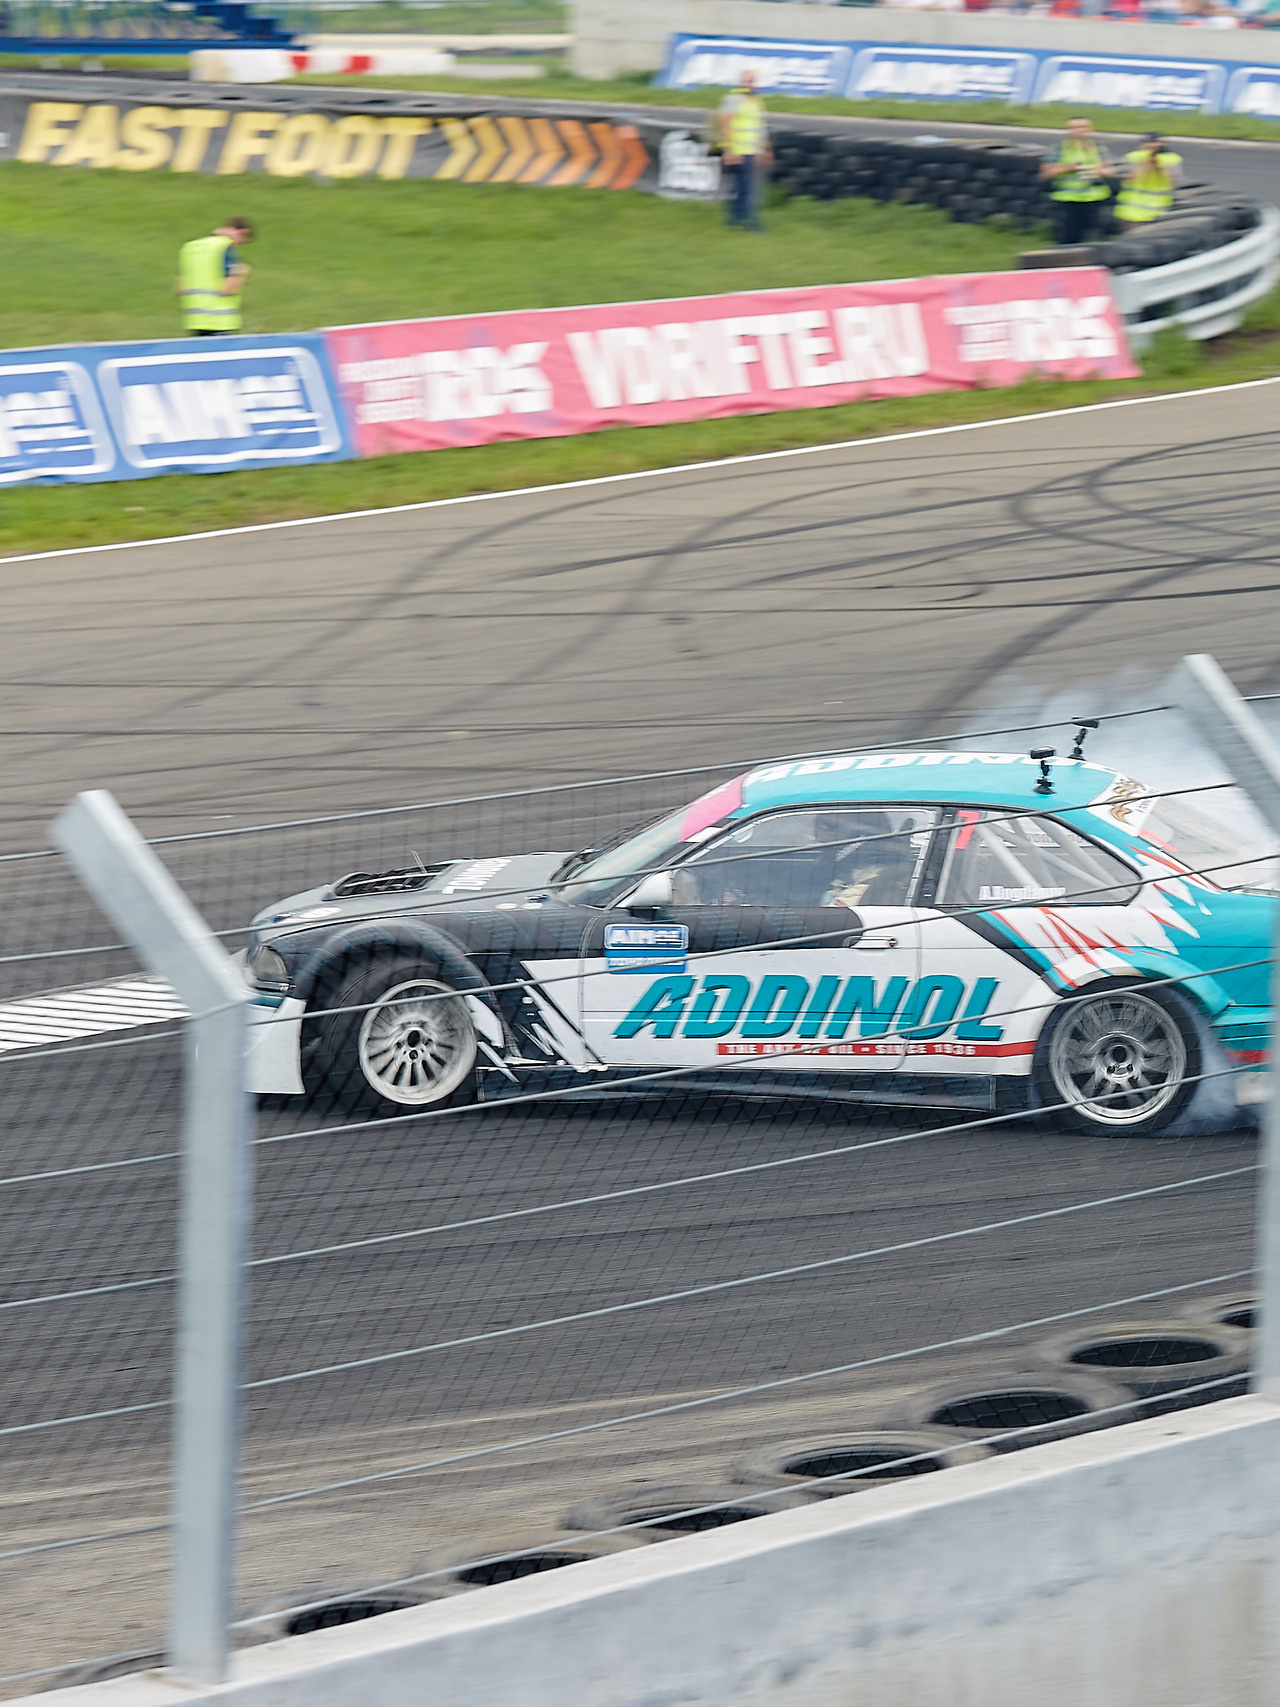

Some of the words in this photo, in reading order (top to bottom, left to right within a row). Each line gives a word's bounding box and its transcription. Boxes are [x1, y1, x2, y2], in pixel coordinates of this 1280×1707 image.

[16, 101, 230, 173] FAST
[216, 111, 433, 179] FOOT
[955, 810, 980, 850] 7
[610, 974, 1007, 1041] ADDINOL
[725, 1044, 757, 1055] THE
[876, 1044, 927, 1055] SINCE
